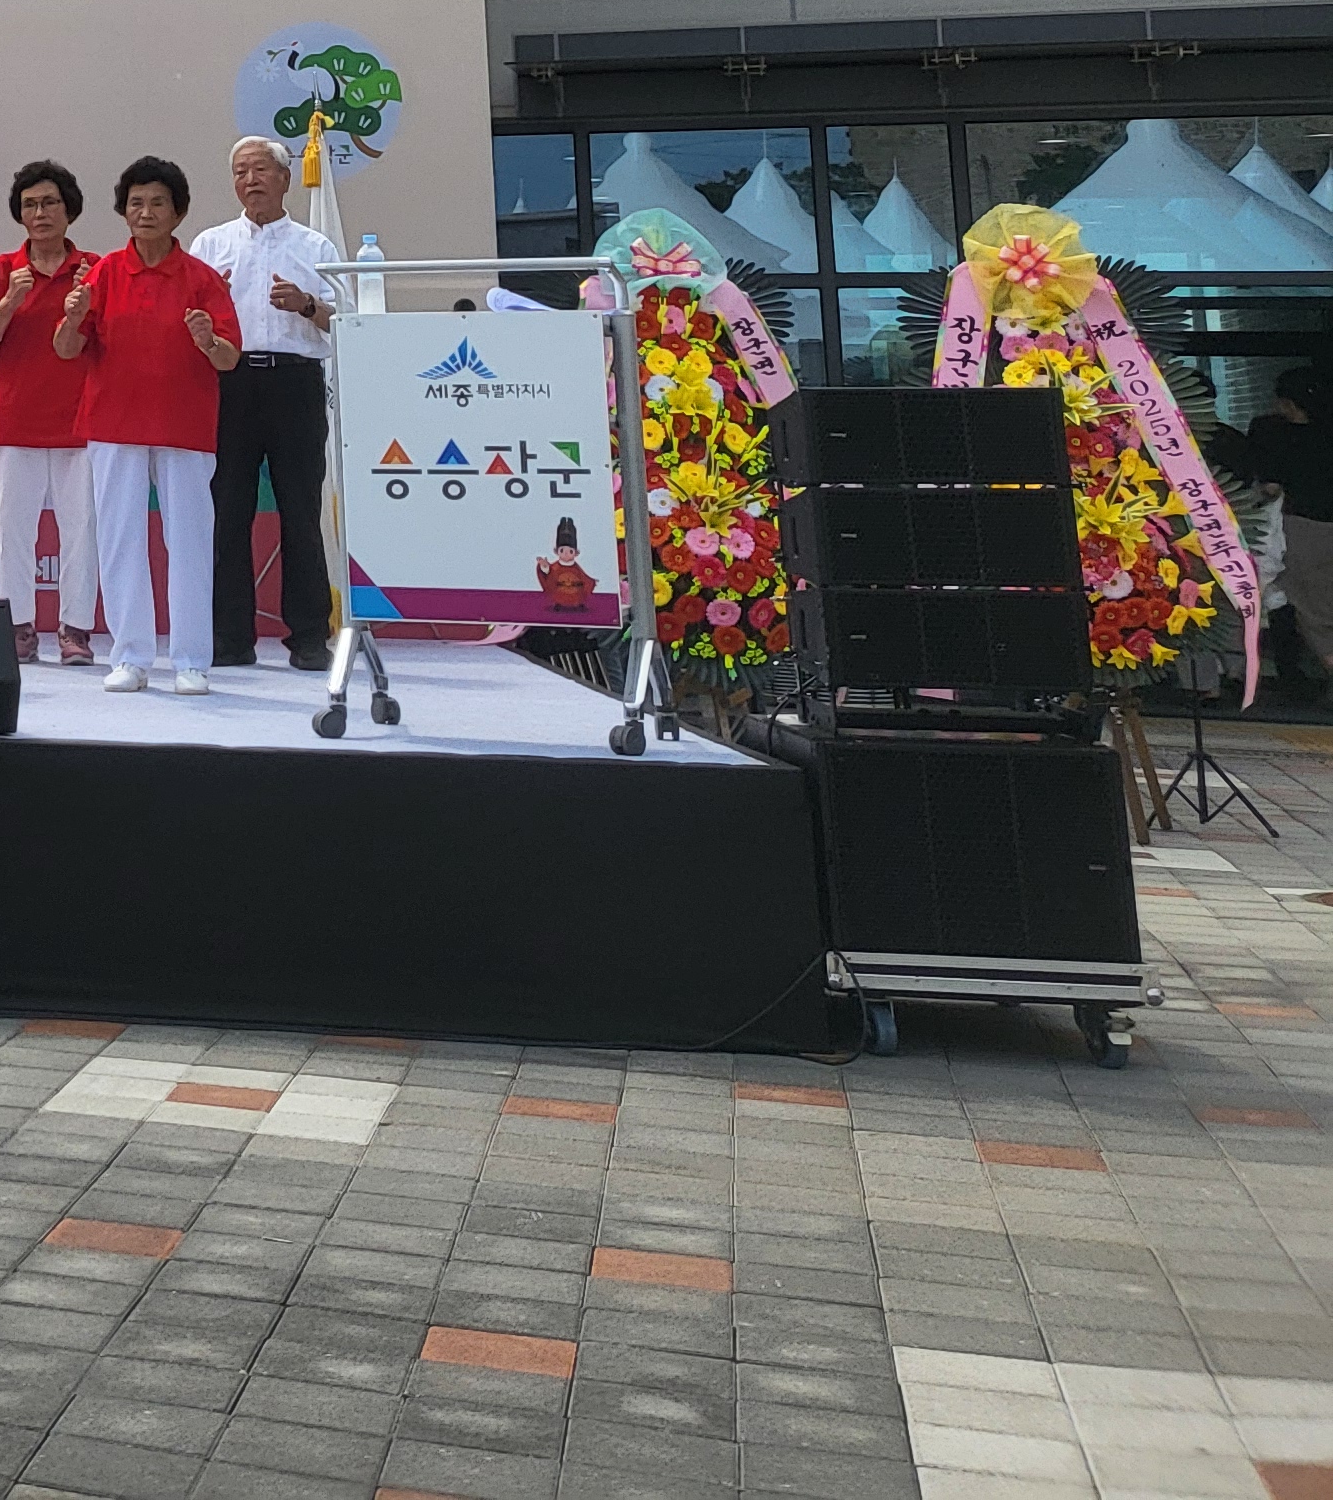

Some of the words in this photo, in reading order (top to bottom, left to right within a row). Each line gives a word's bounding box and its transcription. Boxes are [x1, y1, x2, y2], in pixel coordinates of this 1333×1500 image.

[732, 317, 778, 376] 장군면
[944, 315, 982, 388] 장군
[1089, 319, 1129, 341] 祝
[424, 383, 474, 408] 세종
[1116, 359, 1184, 457] 2025년
[370, 437, 592, 501] 승승장군
